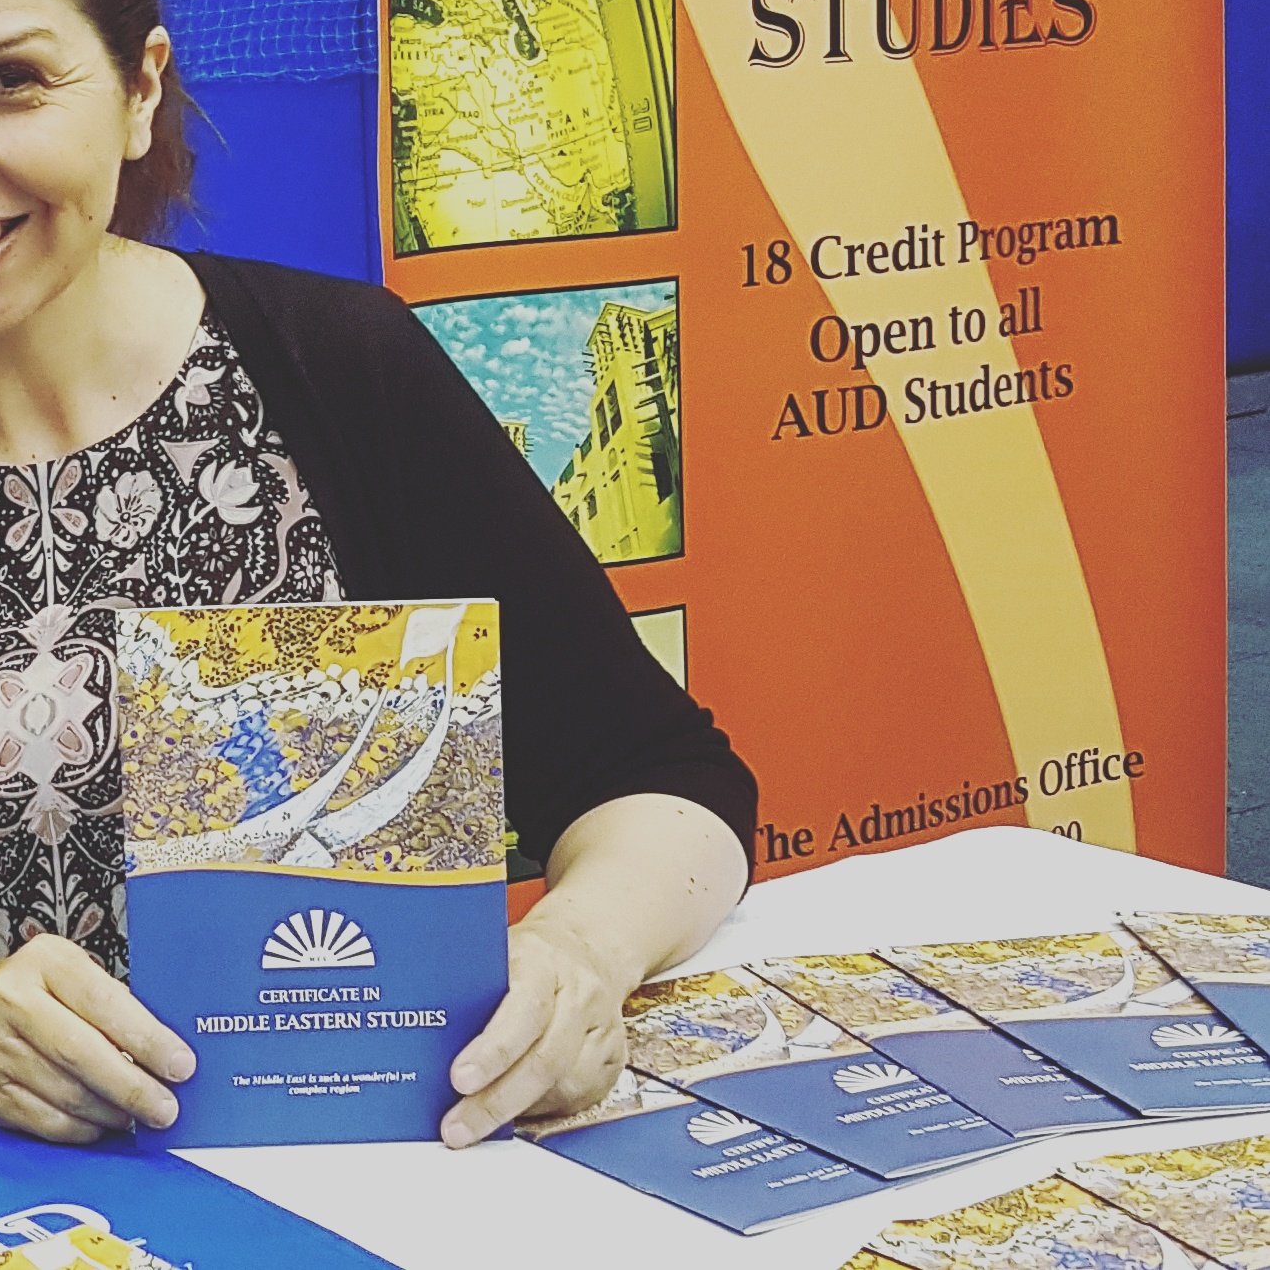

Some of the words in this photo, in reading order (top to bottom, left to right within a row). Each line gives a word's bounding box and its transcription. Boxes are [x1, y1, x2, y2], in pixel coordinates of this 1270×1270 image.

[741, 239, 792, 288] 18
[810, 223, 945, 279] Credit
[958, 213, 1122, 265] Program
[810, 314, 936, 370] Open
[949, 305, 986, 345] to
[998, 286, 1043, 337] all
[771, 383, 888, 441] AUD
[904, 358, 1075, 424] Students
[754, 823, 815, 864] he
[827, 776, 1029, 852] Admissions
[1039, 748, 1146, 797] Office
[196, 1014, 271, 1033] MIDDLE
[274, 1011, 361, 1031] EASTERN
[366, 1010, 447, 1028] STUDIES
[259, 987, 360, 1004] CERTIFICATE
[363, 986, 381, 1001] IN
